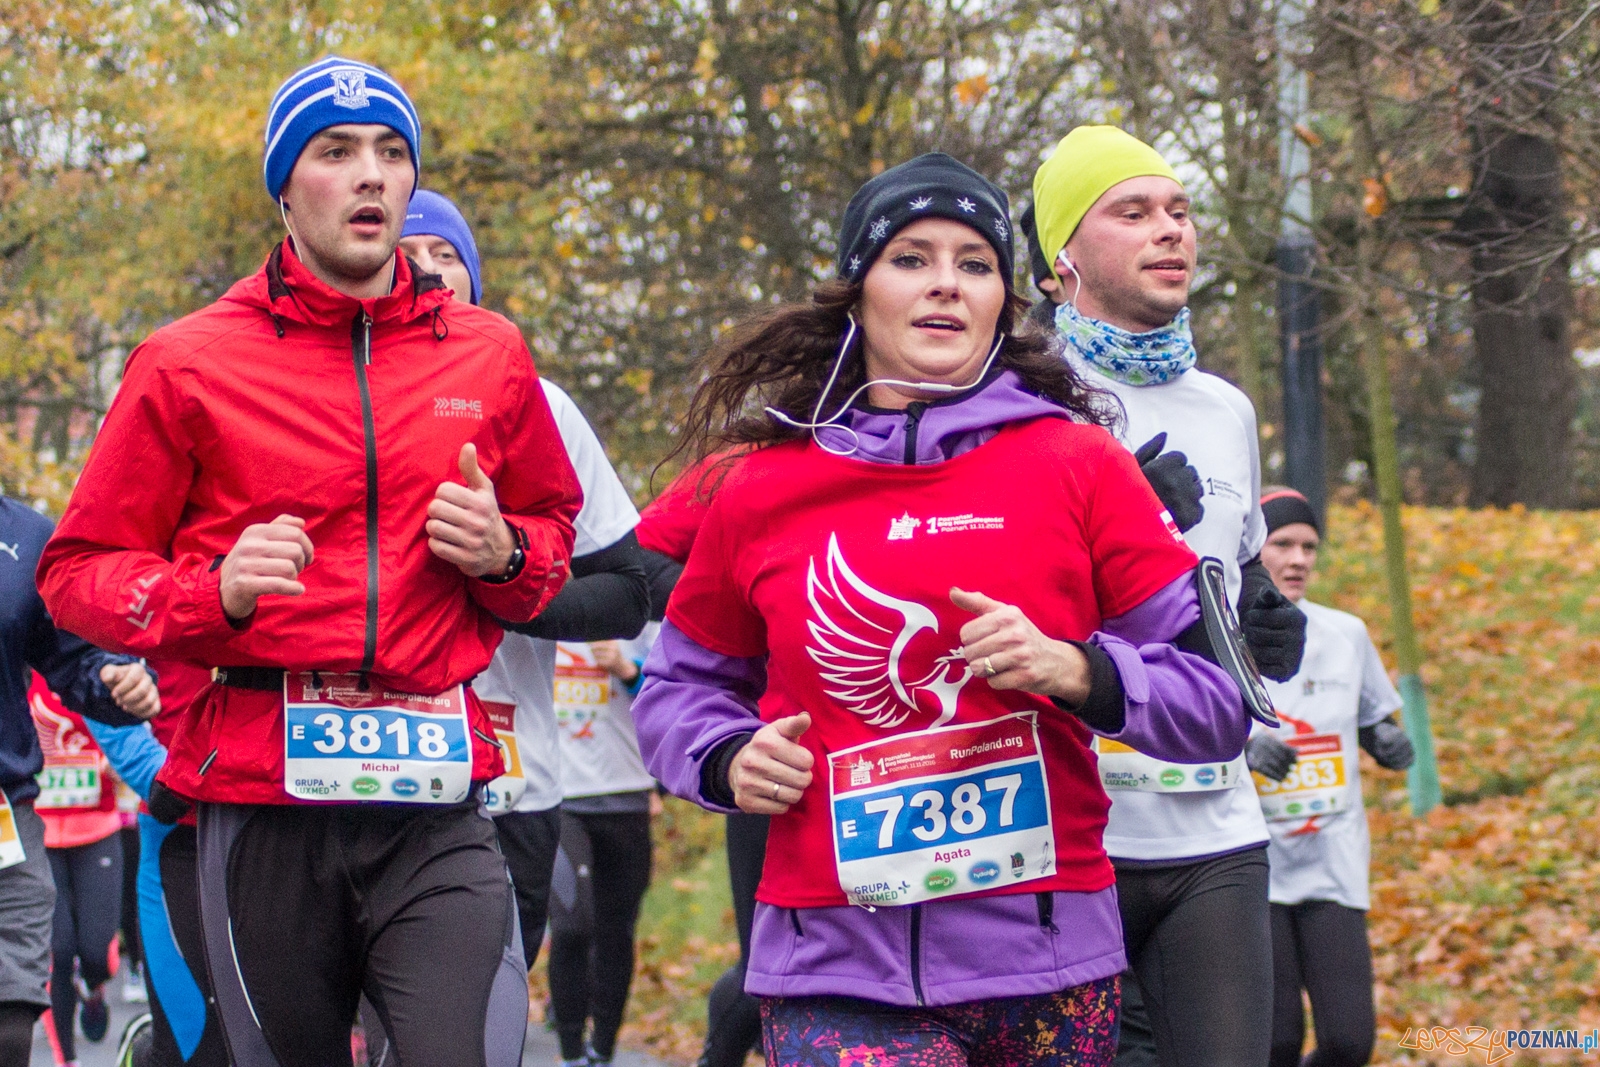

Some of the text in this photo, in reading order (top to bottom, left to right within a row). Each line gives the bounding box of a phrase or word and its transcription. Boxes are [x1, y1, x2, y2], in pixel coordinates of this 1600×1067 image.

[451, 398, 482, 412] BIKE
[926, 516, 938, 534] 1
[383, 691, 451, 708] RunPoland.org
[292, 713, 450, 758] E 3818
[950, 736, 1023, 759] RunPoland.org
[361, 763, 400, 773] Michał
[877, 757, 888, 776] 1
[295, 779, 324, 787] GRUPA
[1105, 779, 1139, 787] LUXMED
[1106, 772, 1134, 780] GRUPA
[295, 786, 330, 795] LUXMED
[842, 773, 1022, 849] E 7387
[934, 847, 972, 864] Agata
[854, 882, 890, 896] GRUPA
[857, 891, 898, 903] LUXMED
